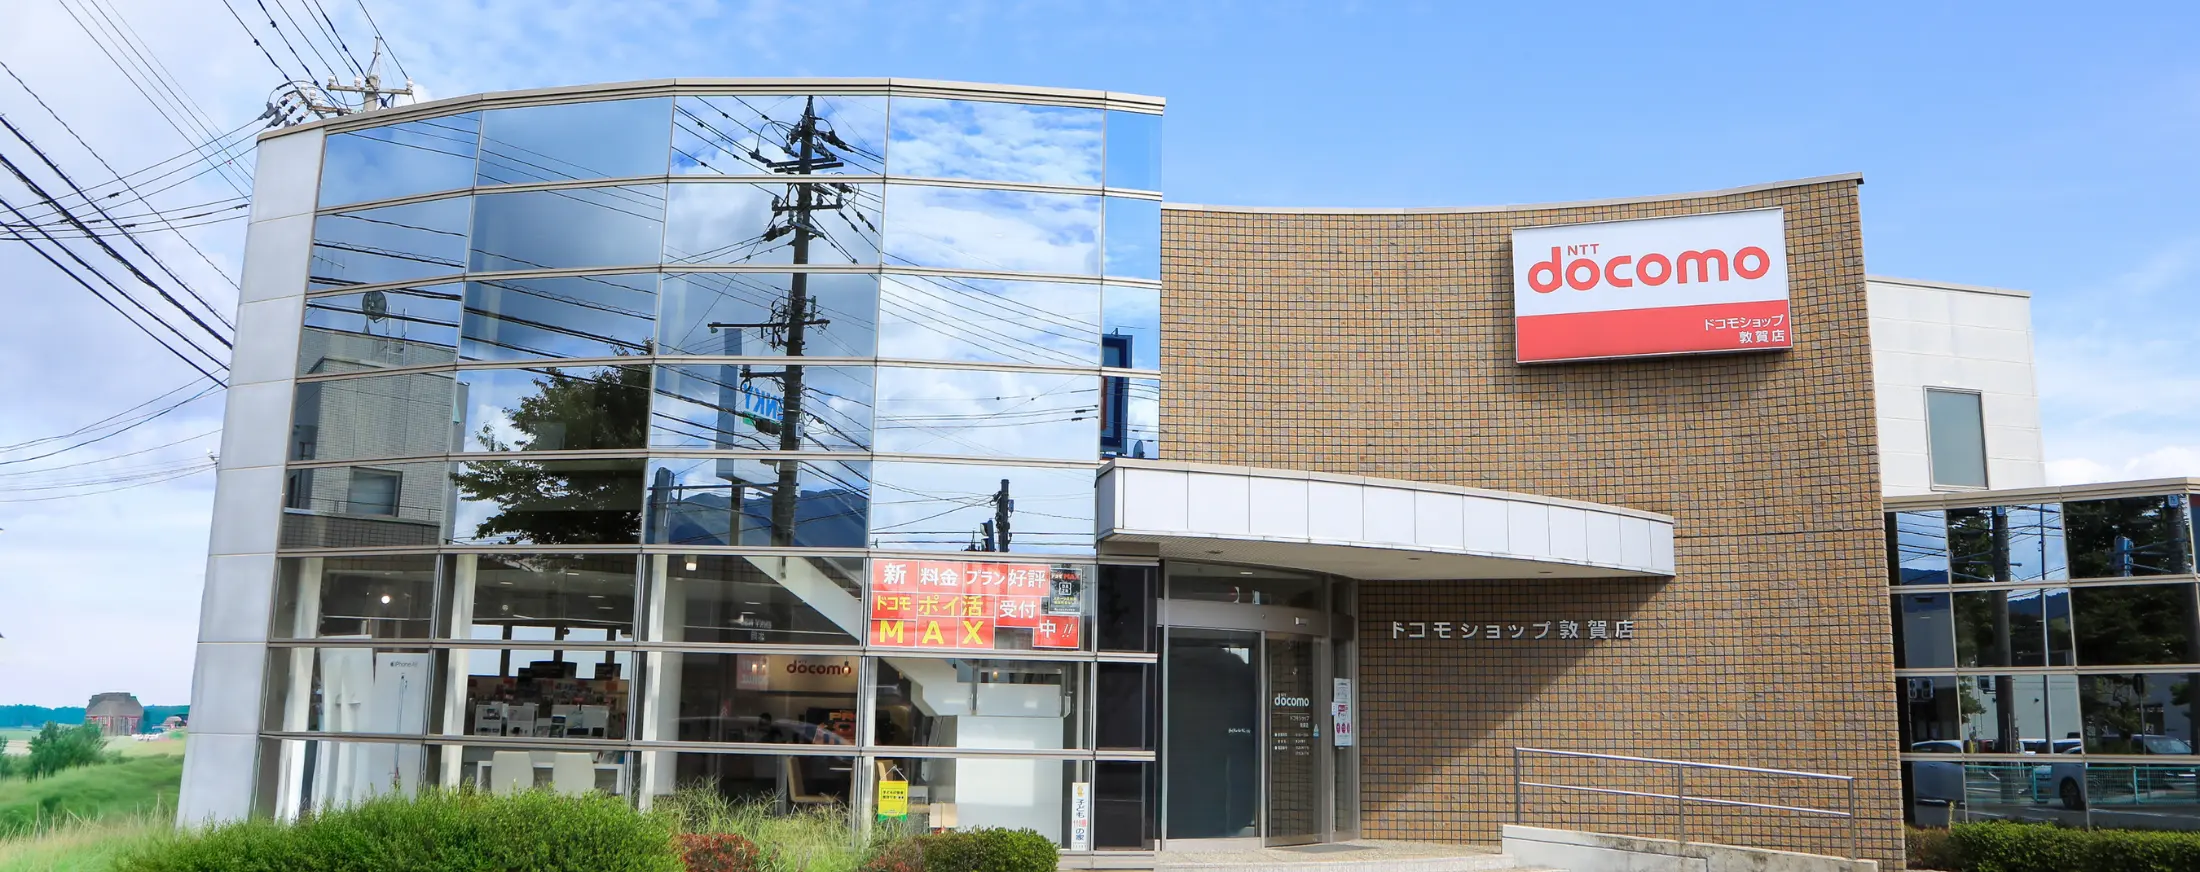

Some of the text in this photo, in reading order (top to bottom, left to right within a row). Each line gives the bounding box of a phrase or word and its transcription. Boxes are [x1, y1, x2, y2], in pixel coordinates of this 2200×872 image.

[1567, 243, 1600, 256] NTT
[1527, 246, 1770, 294] docomo
[1704, 313, 1784, 331] ドコモショップ
[1738, 329, 1785, 344] 敦賀店
[879, 619, 984, 645] MAX
[1392, 619, 1634, 640] ドコモショップ敦賀店
[786, 660, 851, 676] docomo
[1274, 693, 1310, 707] docomo
